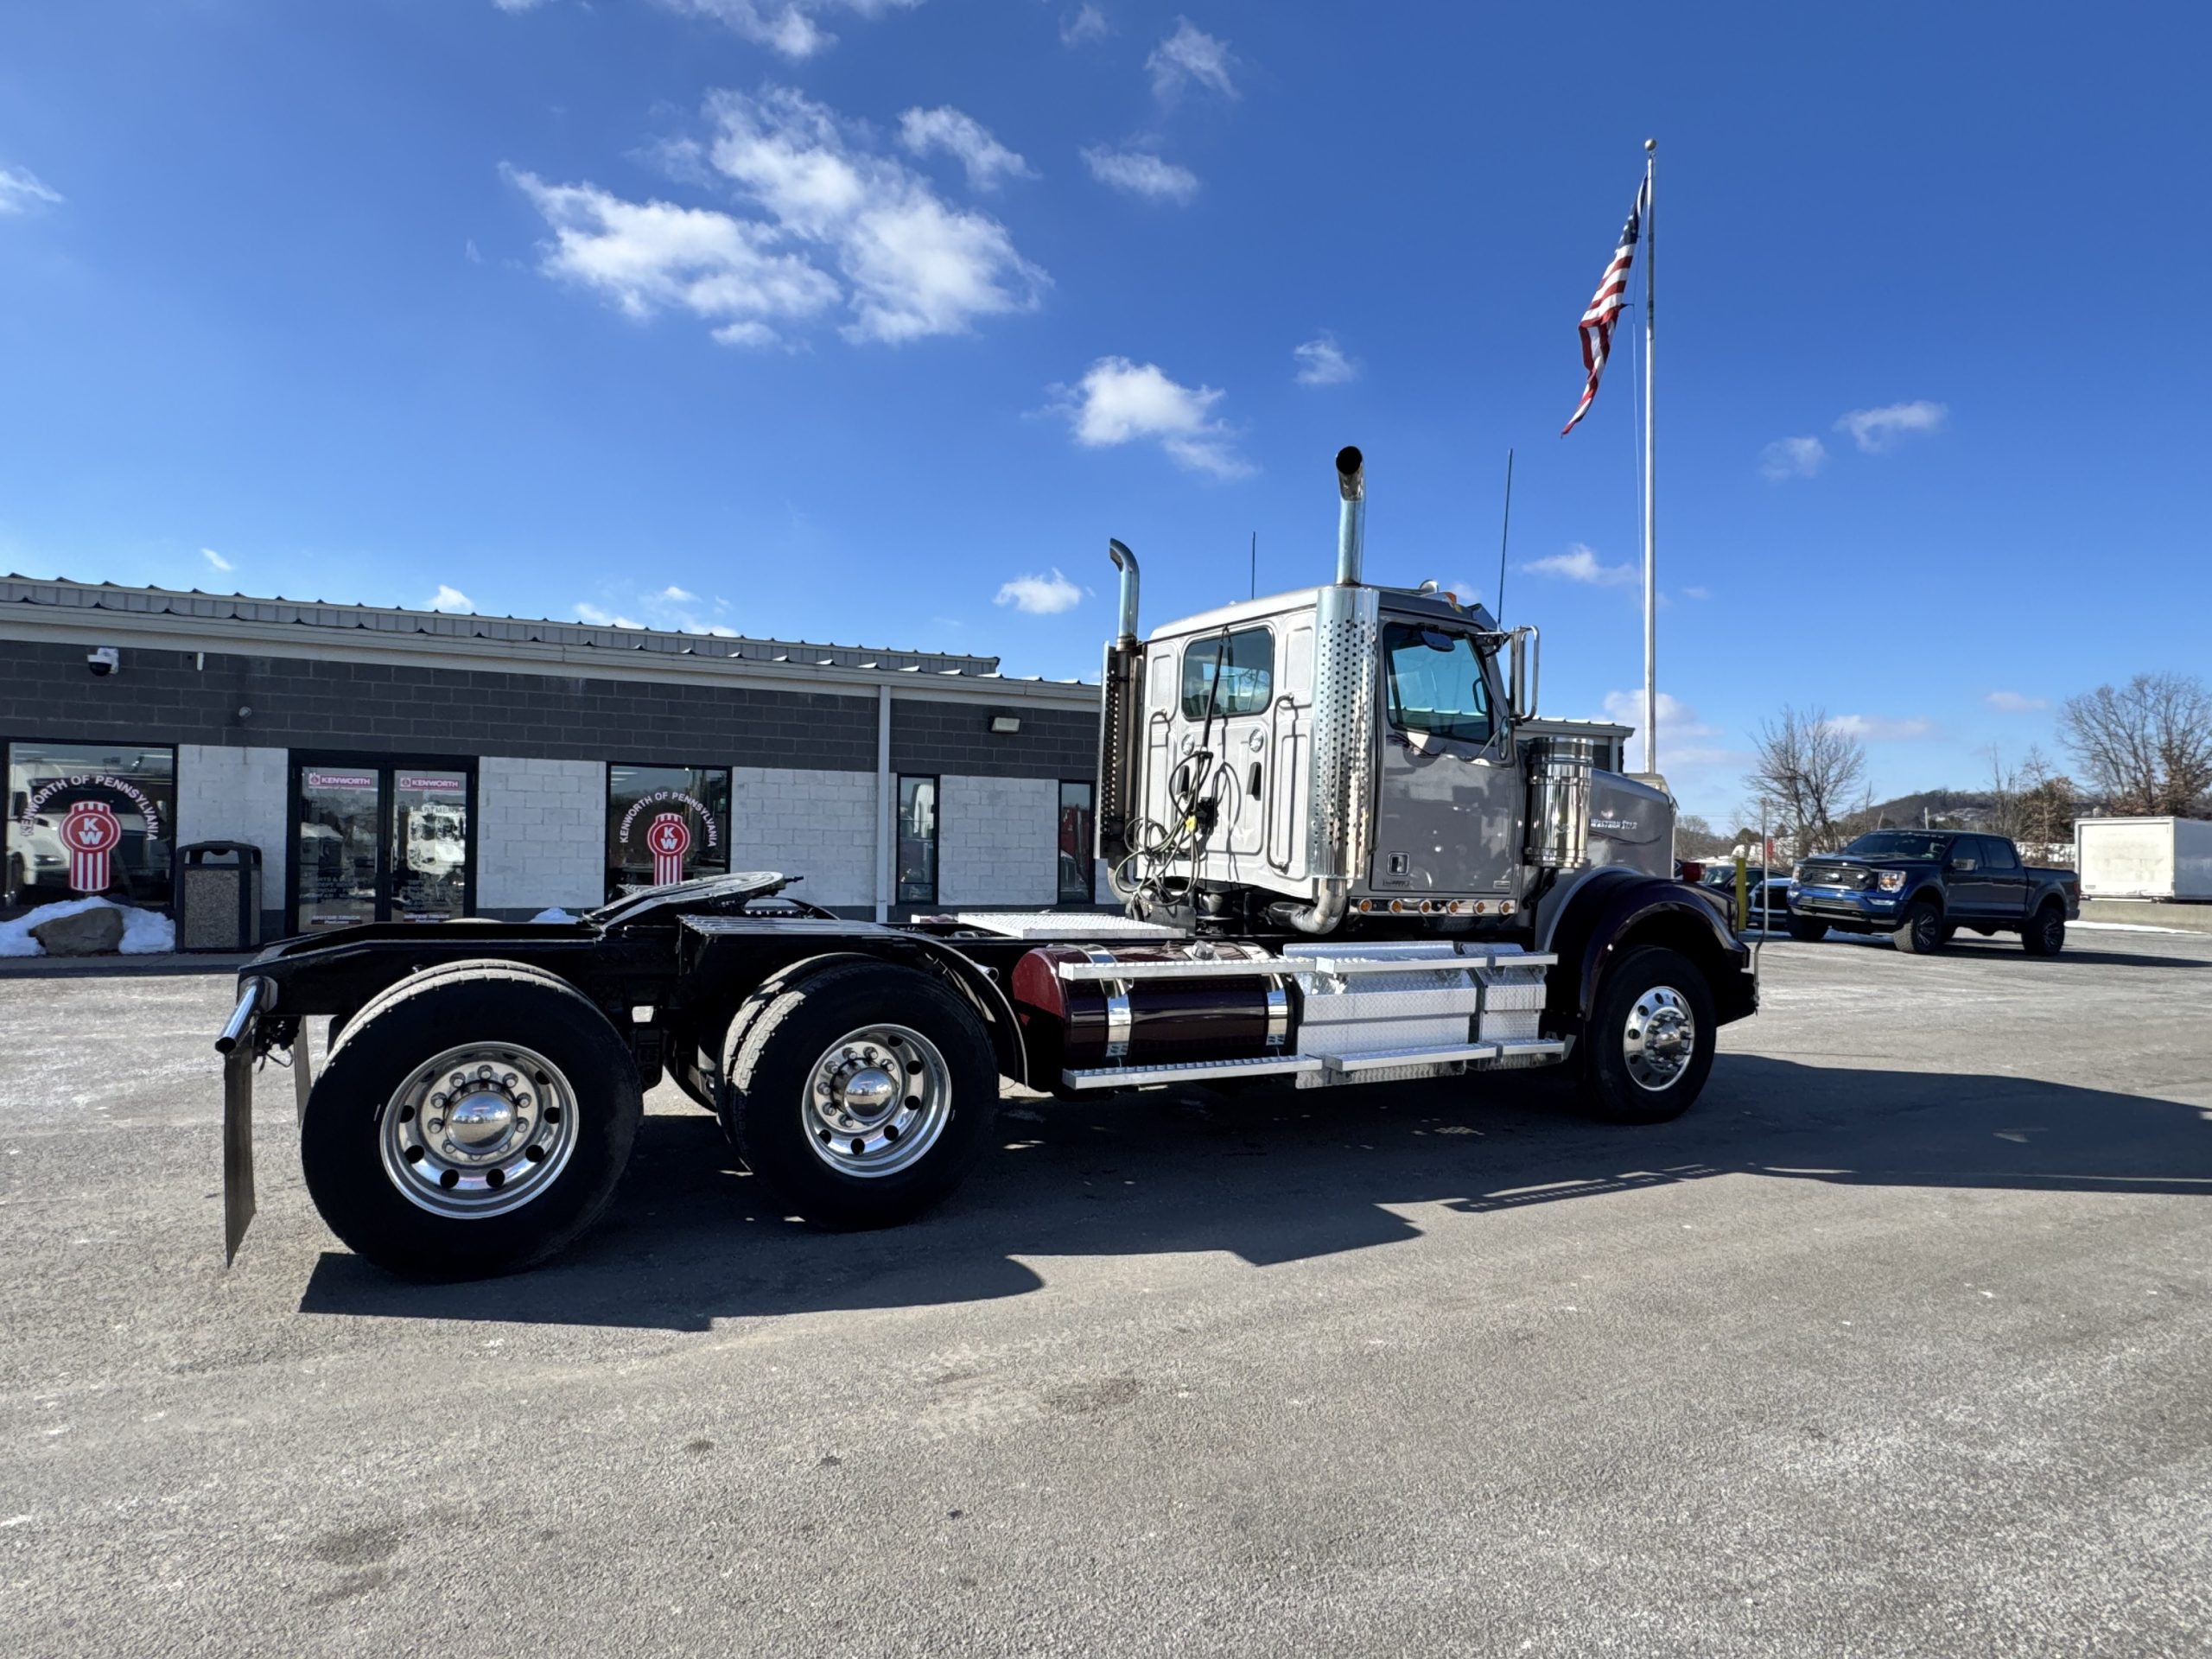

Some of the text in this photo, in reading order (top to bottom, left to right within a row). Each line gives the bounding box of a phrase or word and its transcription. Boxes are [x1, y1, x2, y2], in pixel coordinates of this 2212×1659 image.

[21, 775, 160, 841] KENWORTH OF PENNSYLVANIA
[620, 791, 718, 847] KENWORTH OF PENNSYLVANIA
